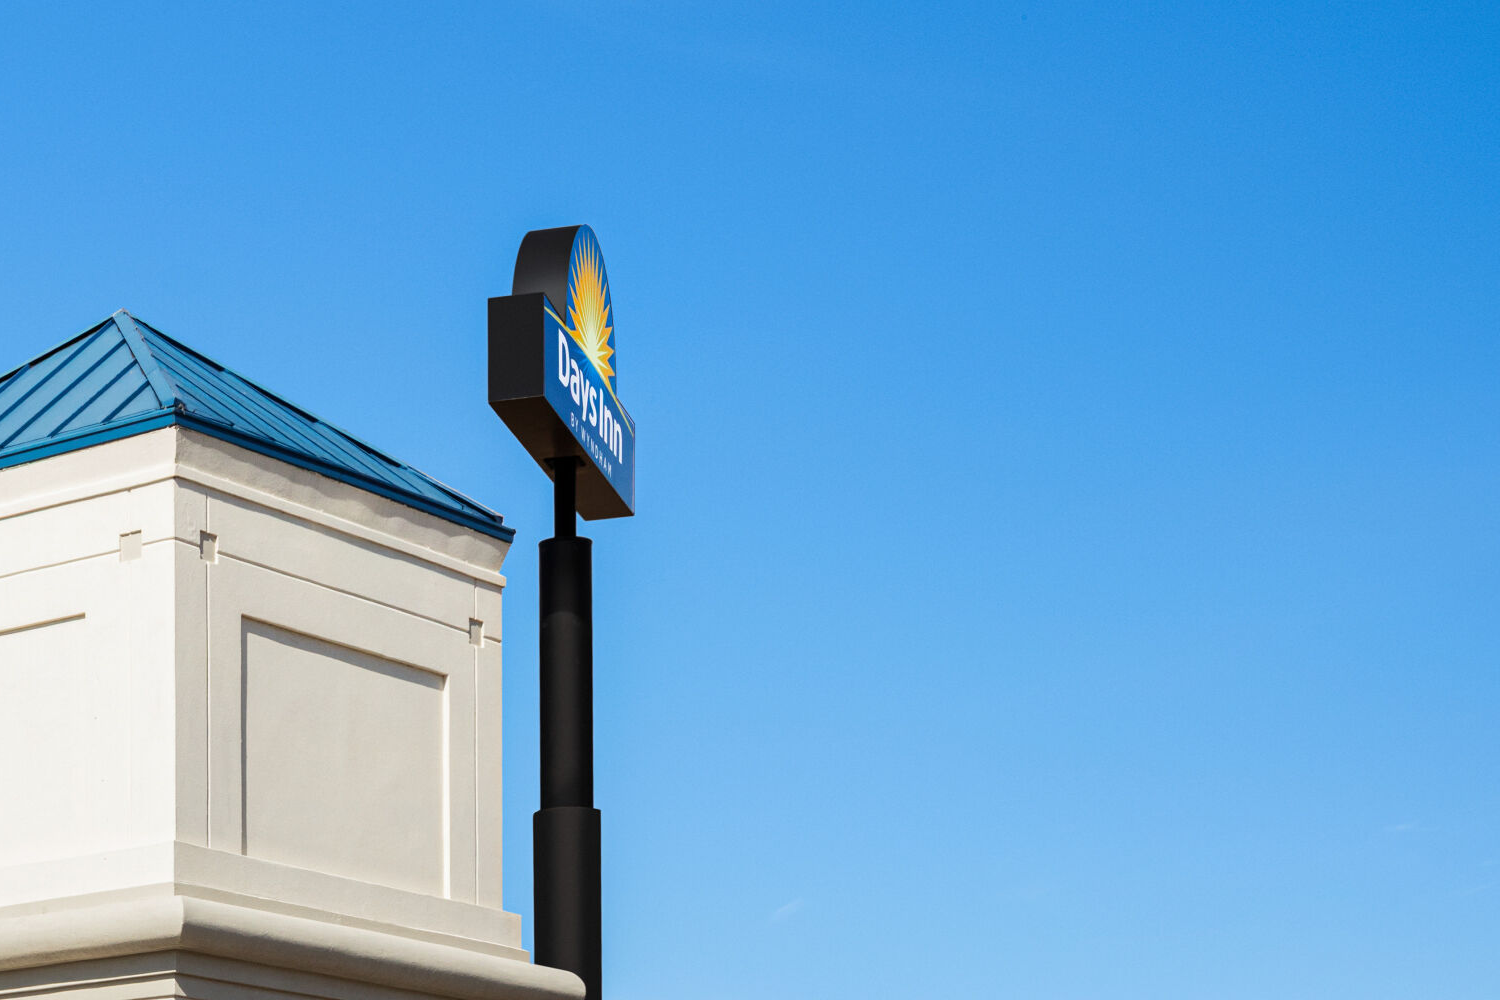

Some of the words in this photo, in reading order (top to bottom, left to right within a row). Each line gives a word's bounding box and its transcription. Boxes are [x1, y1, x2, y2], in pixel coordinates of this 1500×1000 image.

[558, 328, 597, 427] Days
[599, 387, 622, 464] Inn
[570, 412, 579, 433] BY
[581, 430, 612, 478] WYNDHAM
